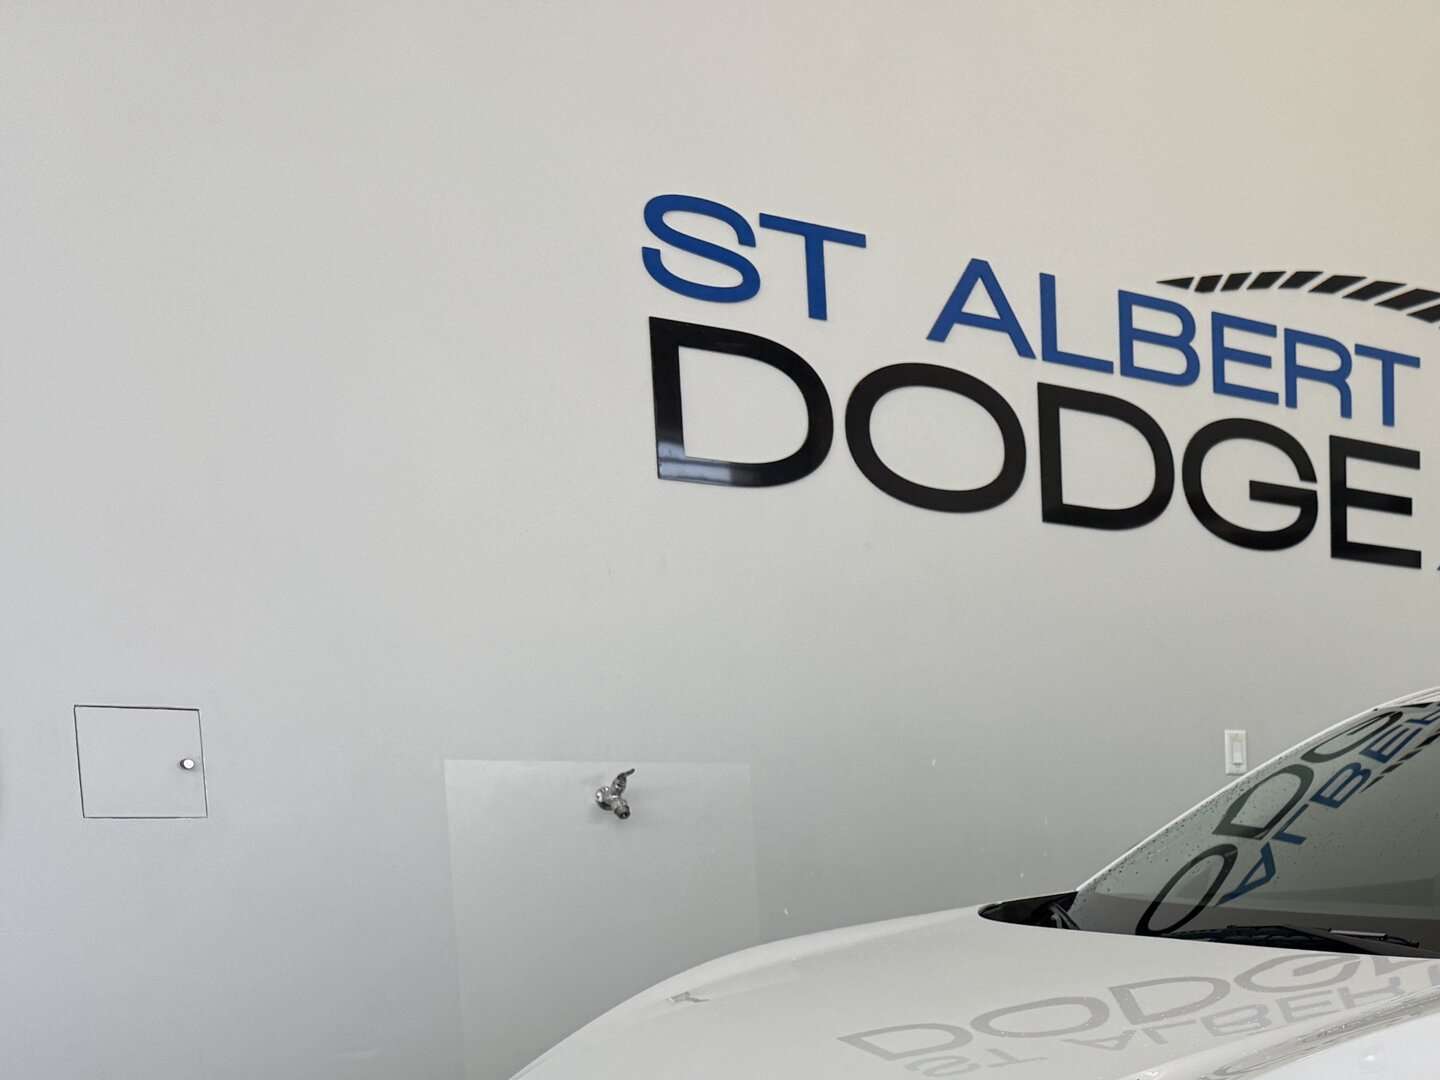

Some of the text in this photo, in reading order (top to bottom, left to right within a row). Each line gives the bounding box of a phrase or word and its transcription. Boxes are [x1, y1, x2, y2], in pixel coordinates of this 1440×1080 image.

[641, 193, 1421, 428] ST ALBERT
[648, 316, 1422, 570] DODGE
